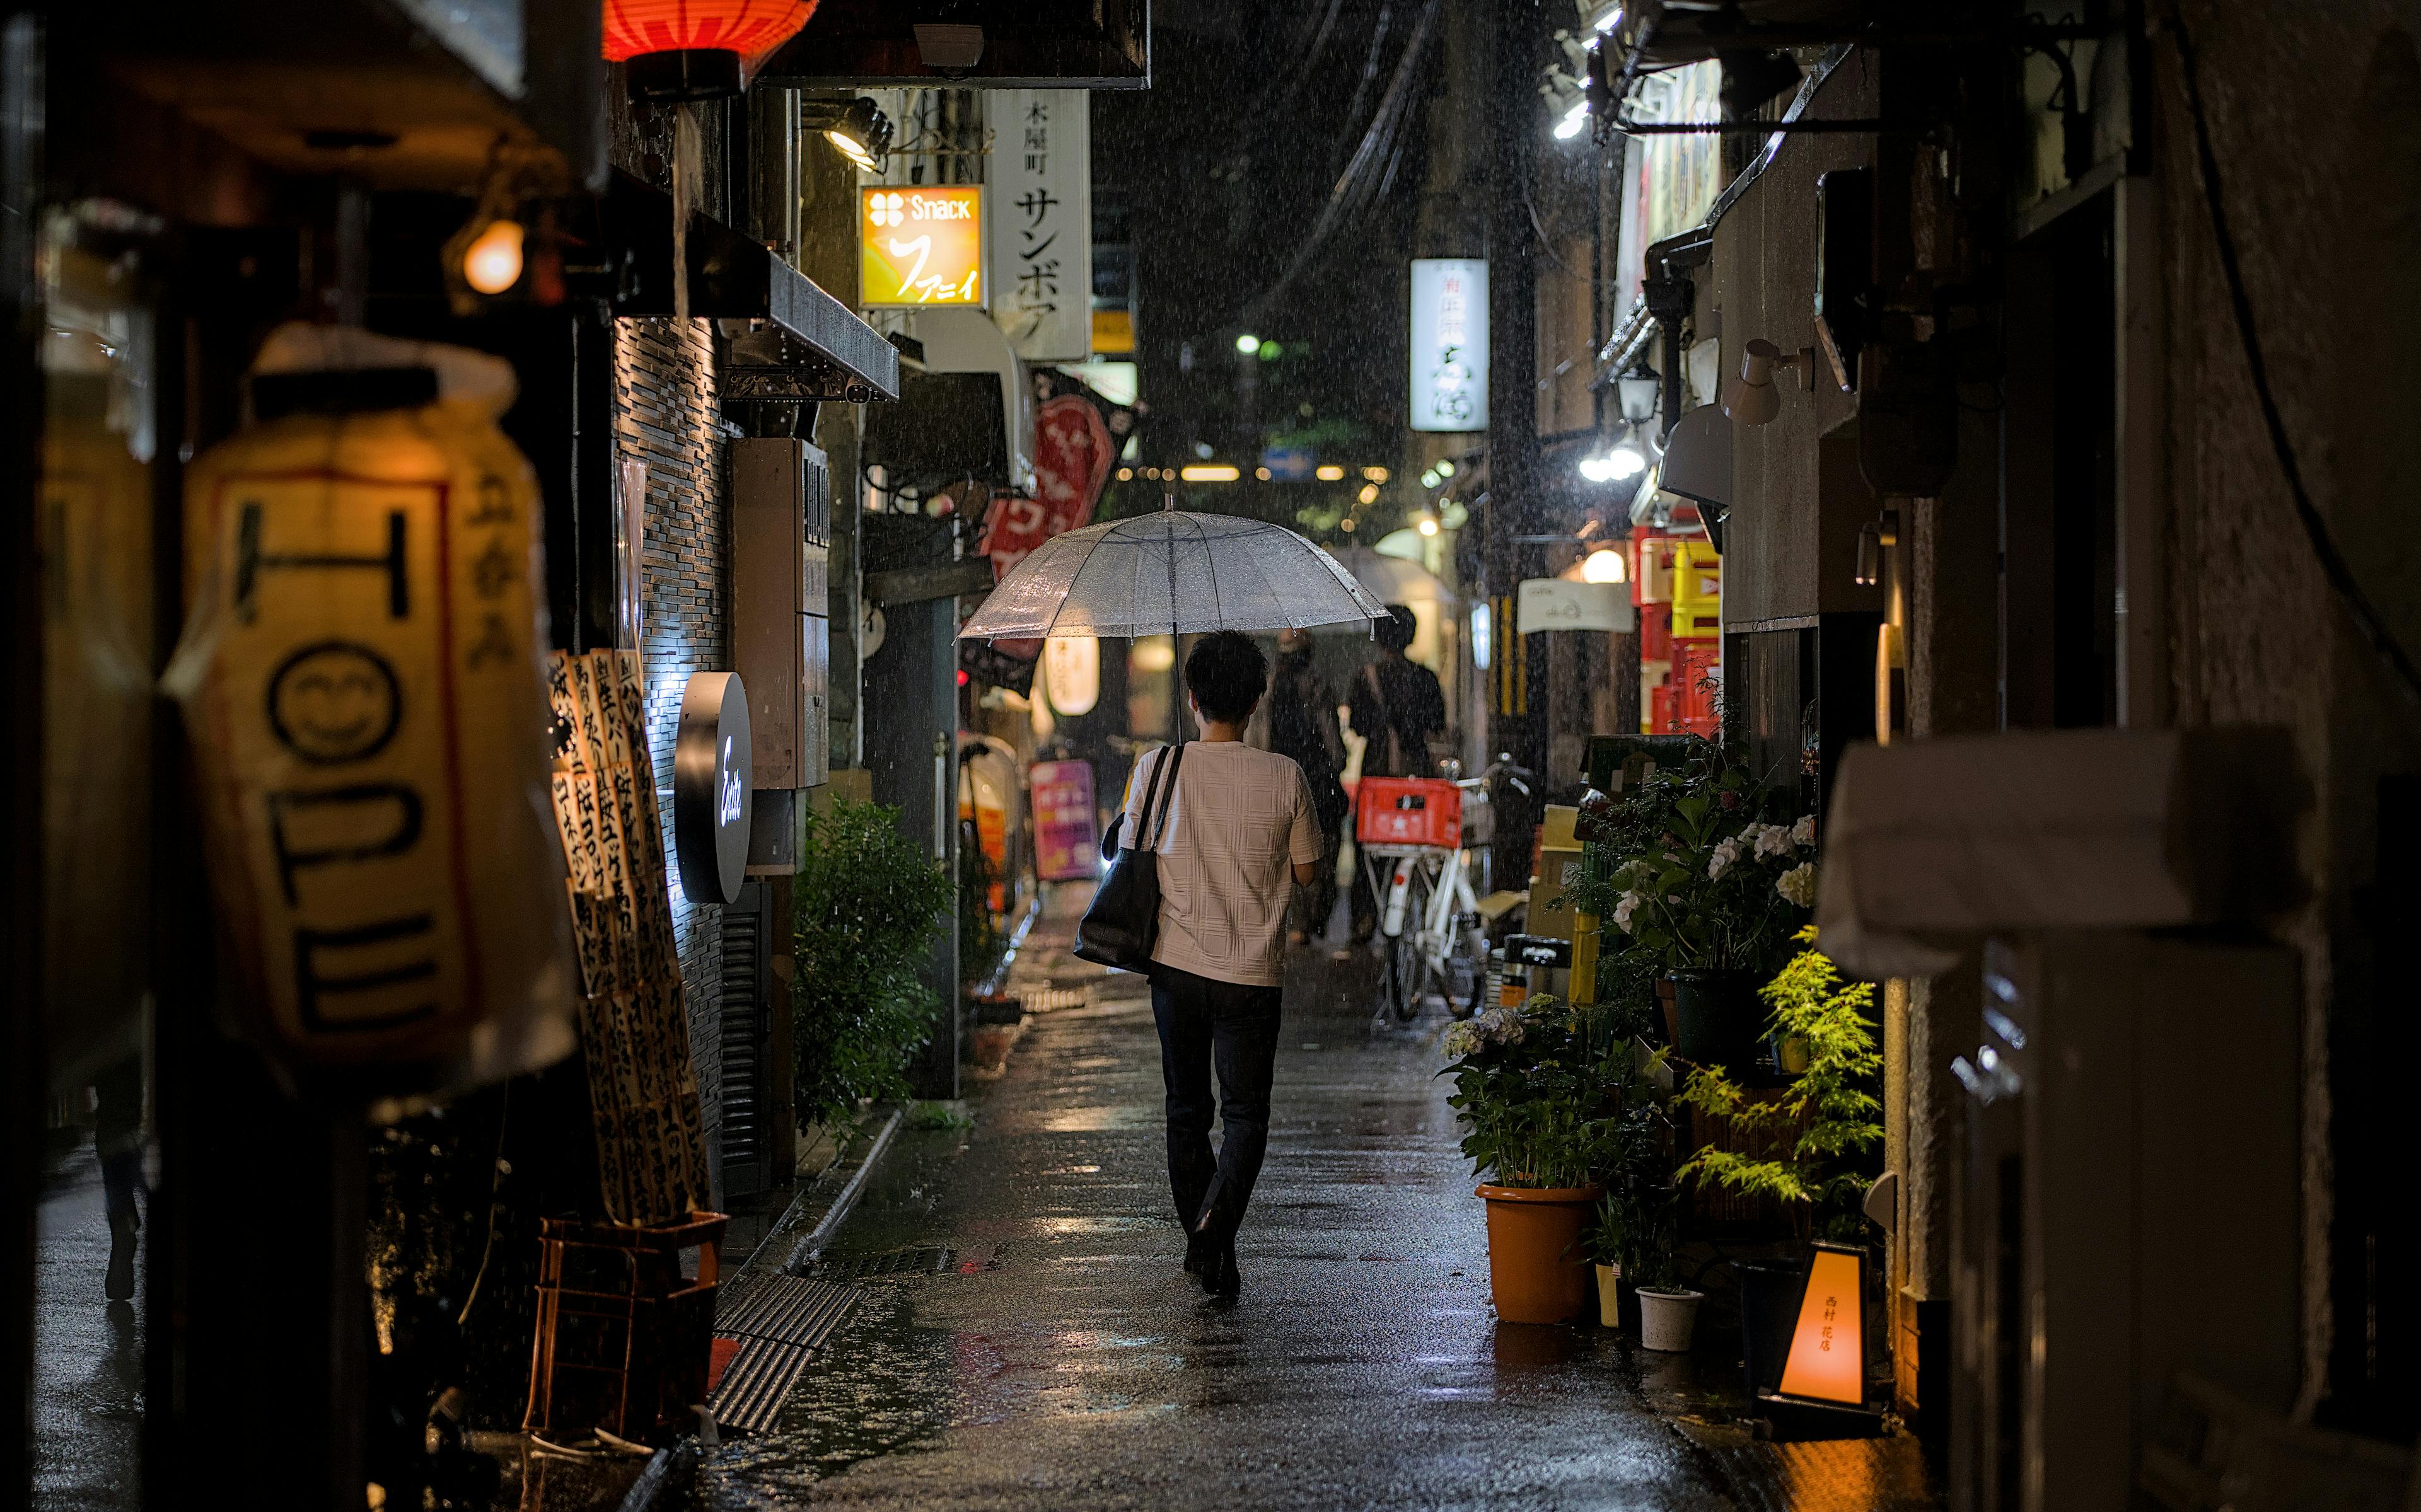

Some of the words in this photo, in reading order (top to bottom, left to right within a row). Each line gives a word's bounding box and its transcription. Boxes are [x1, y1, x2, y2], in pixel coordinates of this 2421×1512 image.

[1023, 100, 1049, 176] 木屋町
[911, 193, 972, 221] Snack
[1014, 187, 1060, 339] サンボア
